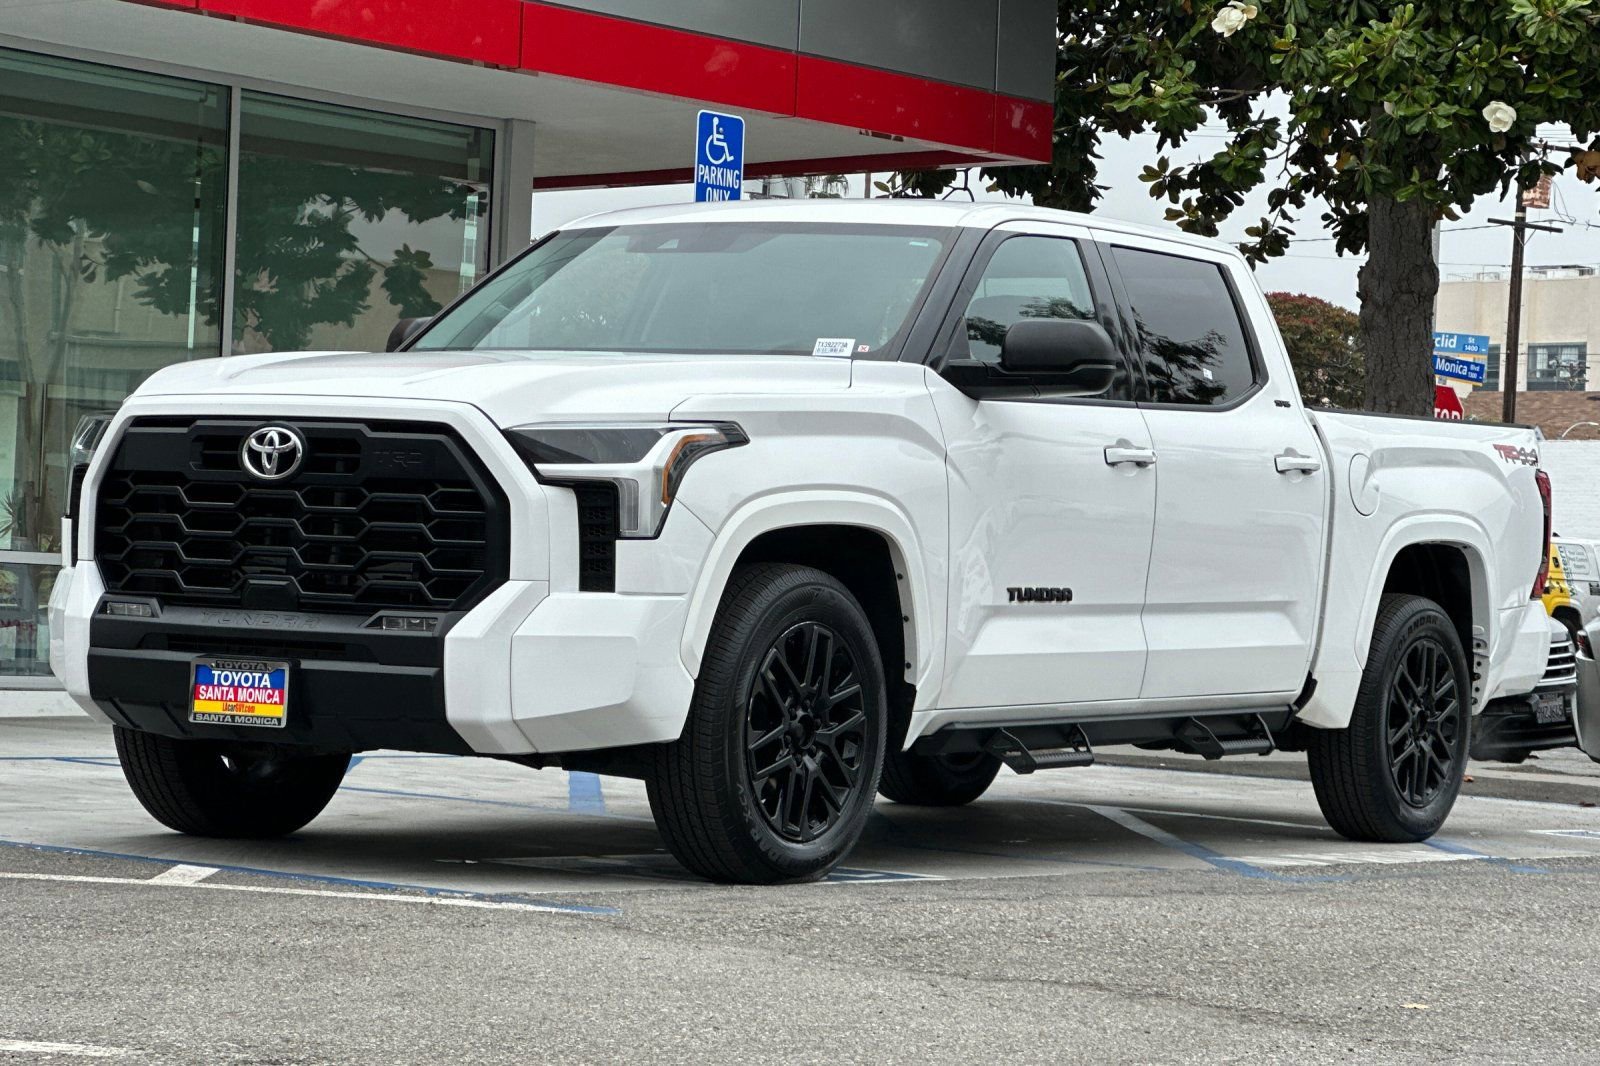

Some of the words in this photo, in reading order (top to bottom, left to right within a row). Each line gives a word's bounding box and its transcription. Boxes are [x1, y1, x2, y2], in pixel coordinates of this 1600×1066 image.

[698, 164, 740, 189] PARKING
[1435, 334, 1457, 348] clid
[1464, 344, 1478, 352] 1400
[1435, 358, 1468, 375] Monica
[1006, 587, 1073, 602] TUNDRA
[201, 609, 322, 629] TUNDRA
[217, 661, 267, 670] TOYOTA
[212, 670, 271, 688] TOYOTA
[199, 685, 235, 701] SANTA
[237, 688, 280, 704] MONICA
[195, 713, 232, 722] SANTA
[235, 715, 279, 725] MONICA
